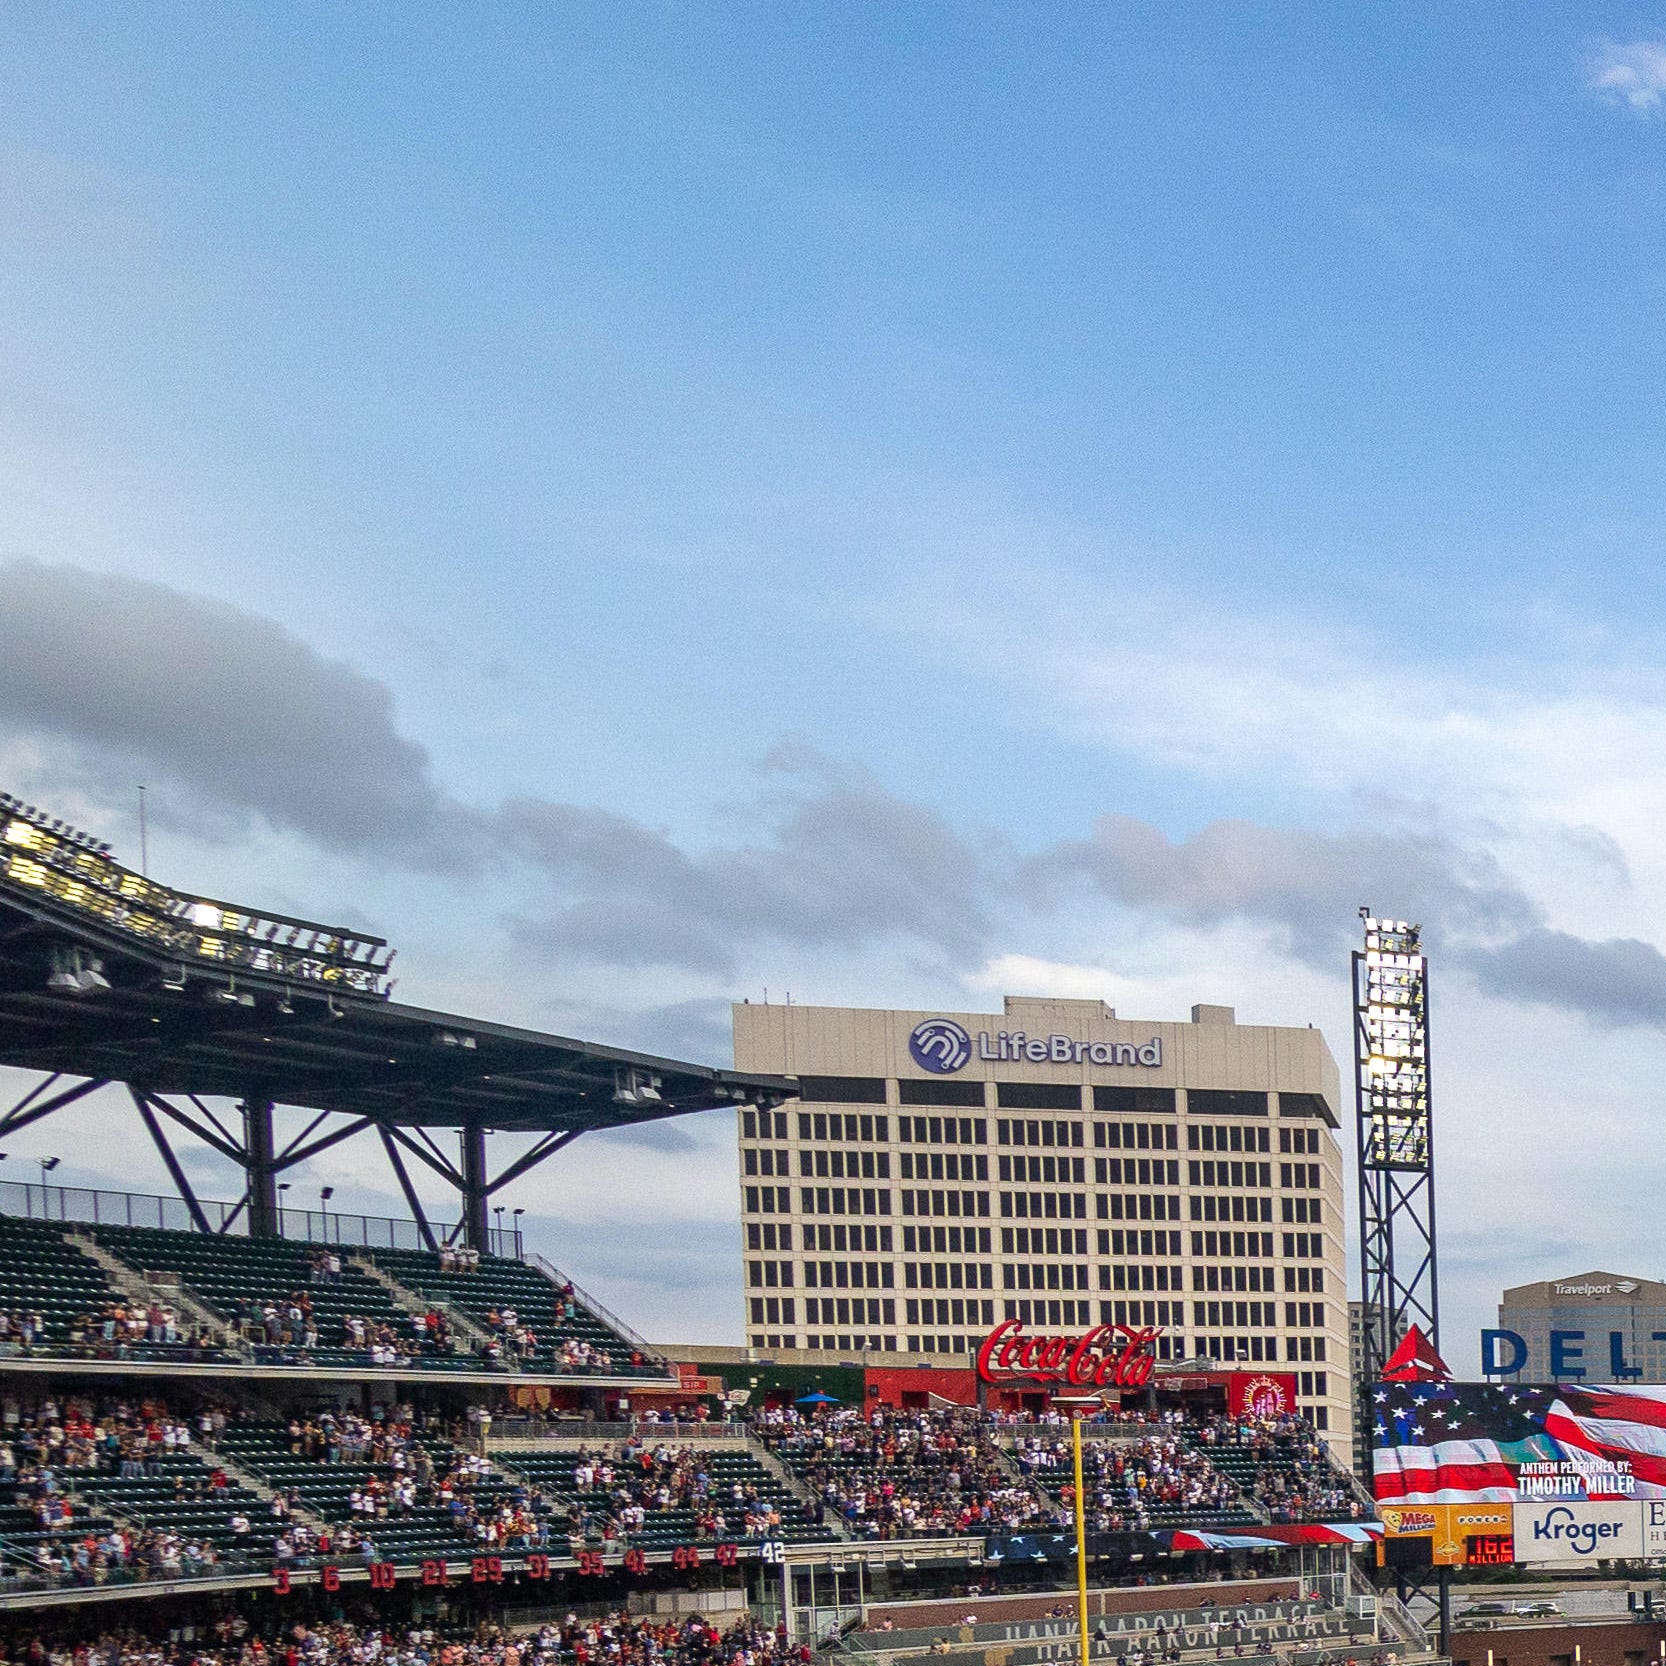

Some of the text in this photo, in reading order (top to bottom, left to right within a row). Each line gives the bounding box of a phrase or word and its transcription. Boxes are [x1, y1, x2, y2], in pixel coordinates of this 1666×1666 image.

[979, 1031, 1162, 1067] LifeBrand
[1554, 1283, 1612, 1297] Travelport
[977, 1319, 1165, 1385] Coca-Cola
[1520, 1461, 1632, 1474] ANTHEM PERFORMED BY:
[1517, 1476, 1635, 1496] TIMOTHY MILLER
[1401, 1512, 1435, 1524] MEGA
[1534, 1506, 1624, 1554] Kroger
[577, 1551, 604, 1575] 35
[624, 1549, 646, 1573] 41
[672, 1546, 700, 1568] 44
[714, 1543, 738, 1567] 47
[760, 1541, 785, 1564] 42
[321, 1565, 339, 1591] 6
[369, 1562, 396, 1589] 10
[421, 1559, 449, 1585] 21
[472, 1556, 503, 1582] 29
[527, 1553, 549, 1579] 31
[271, 1567, 290, 1595] 3
